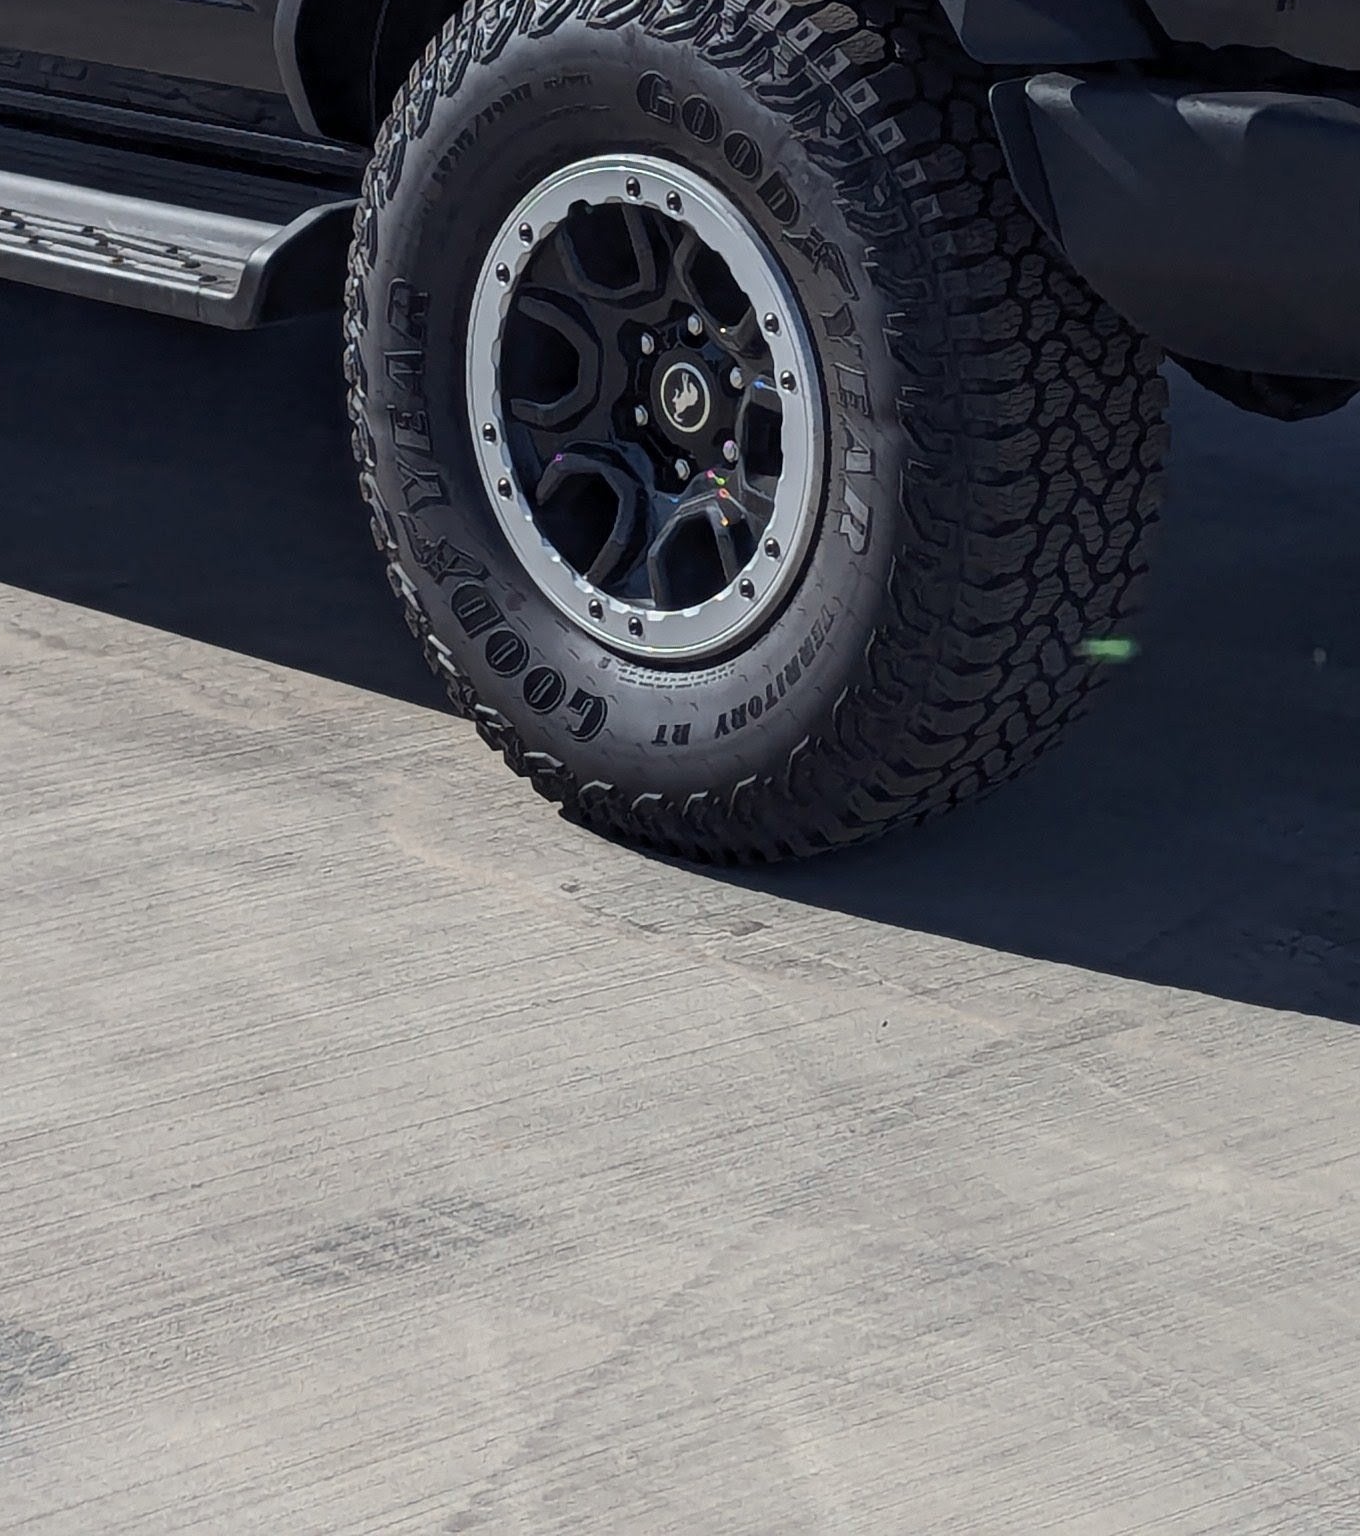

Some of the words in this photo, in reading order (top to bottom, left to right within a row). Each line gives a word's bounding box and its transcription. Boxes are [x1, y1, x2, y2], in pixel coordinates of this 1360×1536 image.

[636, 69, 873, 555] GOODYEAR
[383, 276, 609, 744] GOODYEAR
[649, 722, 692, 747] RT
[713, 604, 836, 739] TERRITORY
